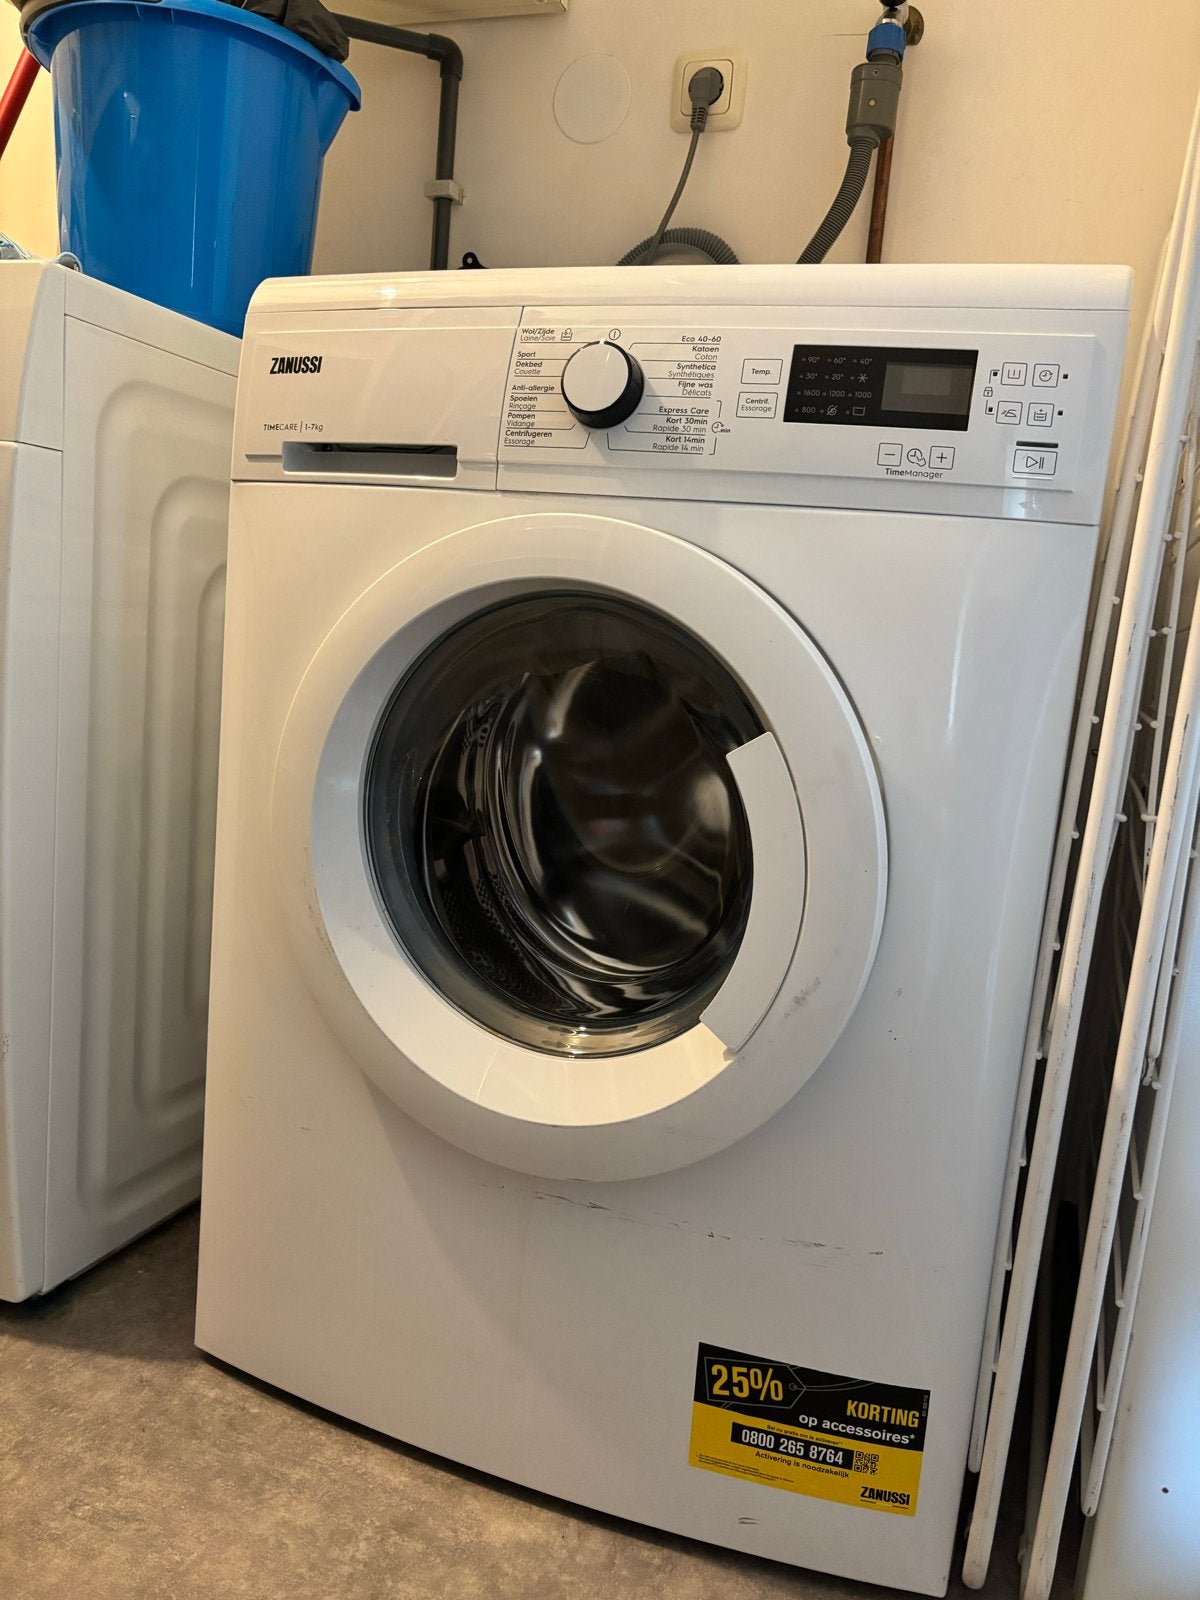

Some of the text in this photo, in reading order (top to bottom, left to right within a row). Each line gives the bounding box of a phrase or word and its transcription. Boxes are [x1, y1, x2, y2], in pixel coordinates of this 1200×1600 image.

[521, 328, 555, 336] Wol/Zijde
[269, 356, 323, 374] ZANUSSI
[676, 362, 716, 370] Synthetica
[751, 368, 772, 376] Temp.
[508, 402, 537, 410] Rinçage
[658, 406, 688, 414] Express
[741, 405, 772, 413] Essorage
[507, 412, 536, 420] Pompen
[263, 423, 323, 432] TIMECARE 1-7kg
[506, 420, 535, 428] Vidange
[652, 424, 679, 433] Rapide
[505, 430, 552, 438] Centrifugeren
[504, 437, 535, 446] Essorage
[665, 435, 682, 443] Kort
[652, 443, 679, 451] Rapide
[885, 468, 943, 479] TimeManager
[711, 1364, 784, 1401] 25%
[846, 1400, 920, 1428] KORTING
[799, 1414, 818, 1427] op
[741, 1428, 843, 1465] 0800 265 8764
[755, 1450, 792, 1466] Activering
[802, 1463, 850, 1478] noodzakelijk
[860, 1486, 910, 1506] ZANUSSI
